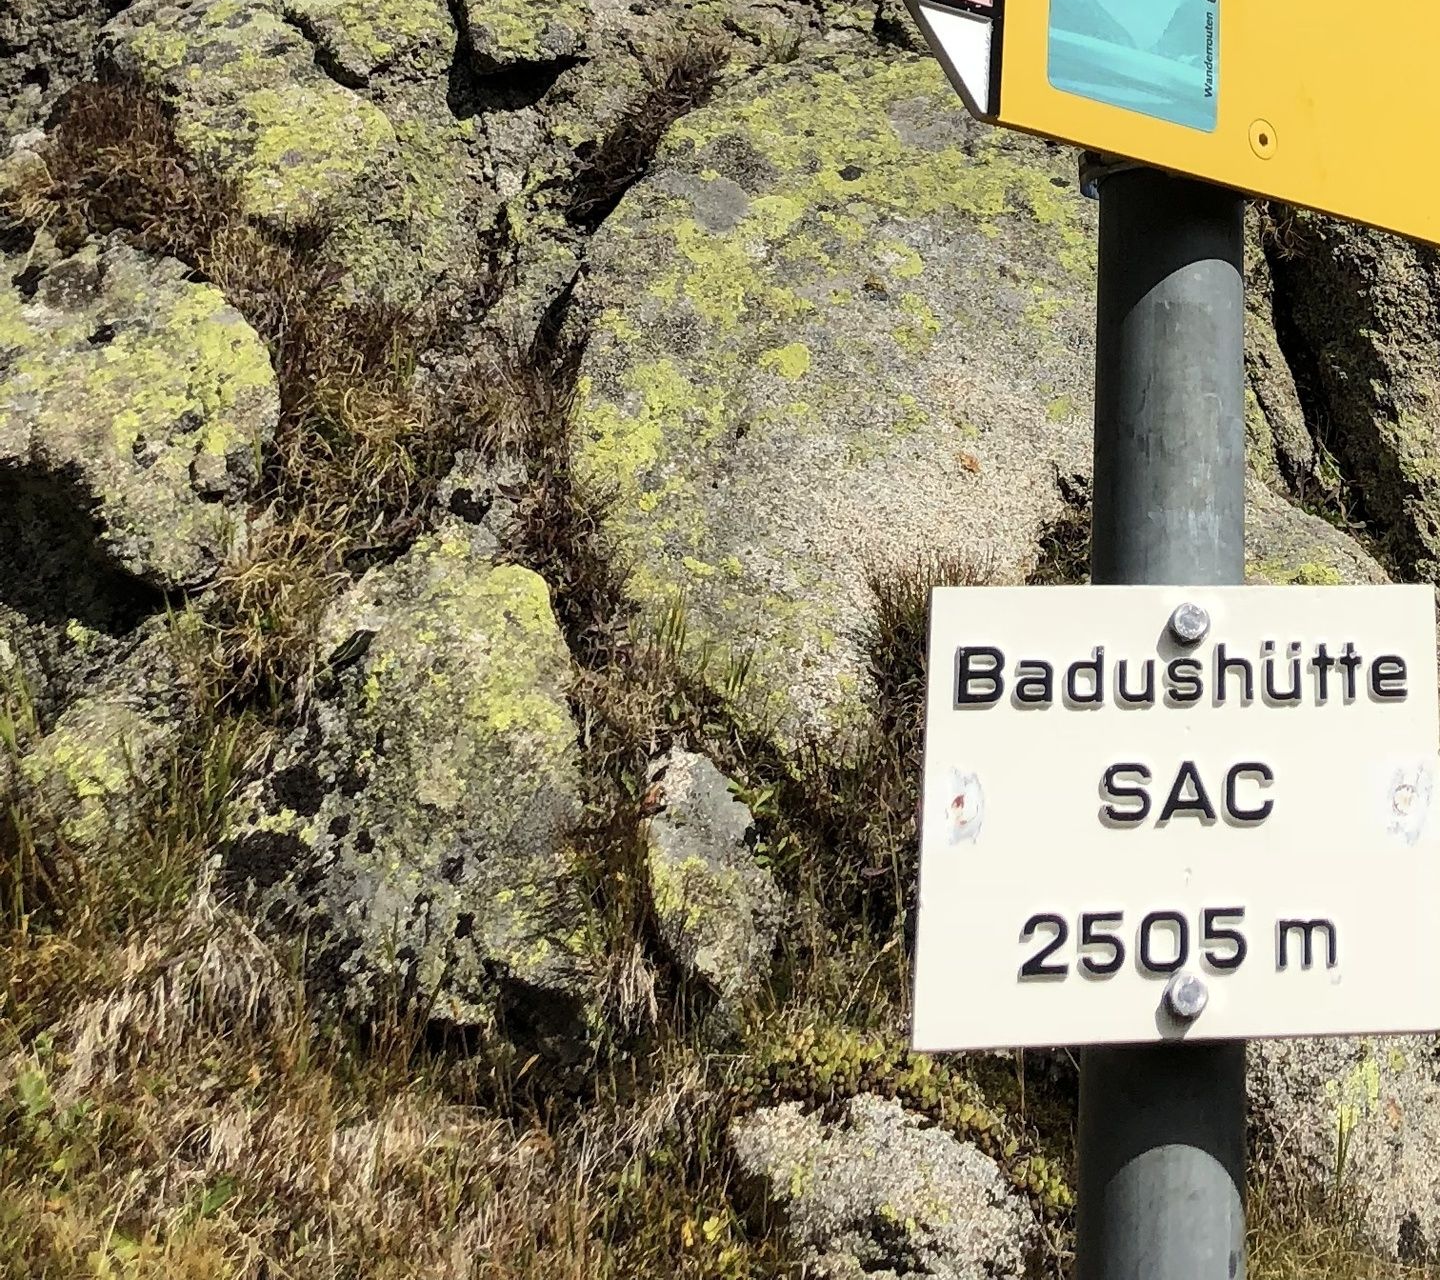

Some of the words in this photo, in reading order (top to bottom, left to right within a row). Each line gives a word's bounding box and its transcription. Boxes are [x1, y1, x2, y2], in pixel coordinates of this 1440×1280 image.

[1204, 12, 1214, 98] Wanderrouten
[955, 641, 1409, 710] Badushütte
[1099, 760, 1275, 828] SAC
[1017, 906, 1248, 983] 2505
[1276, 917, 1337, 972] m
